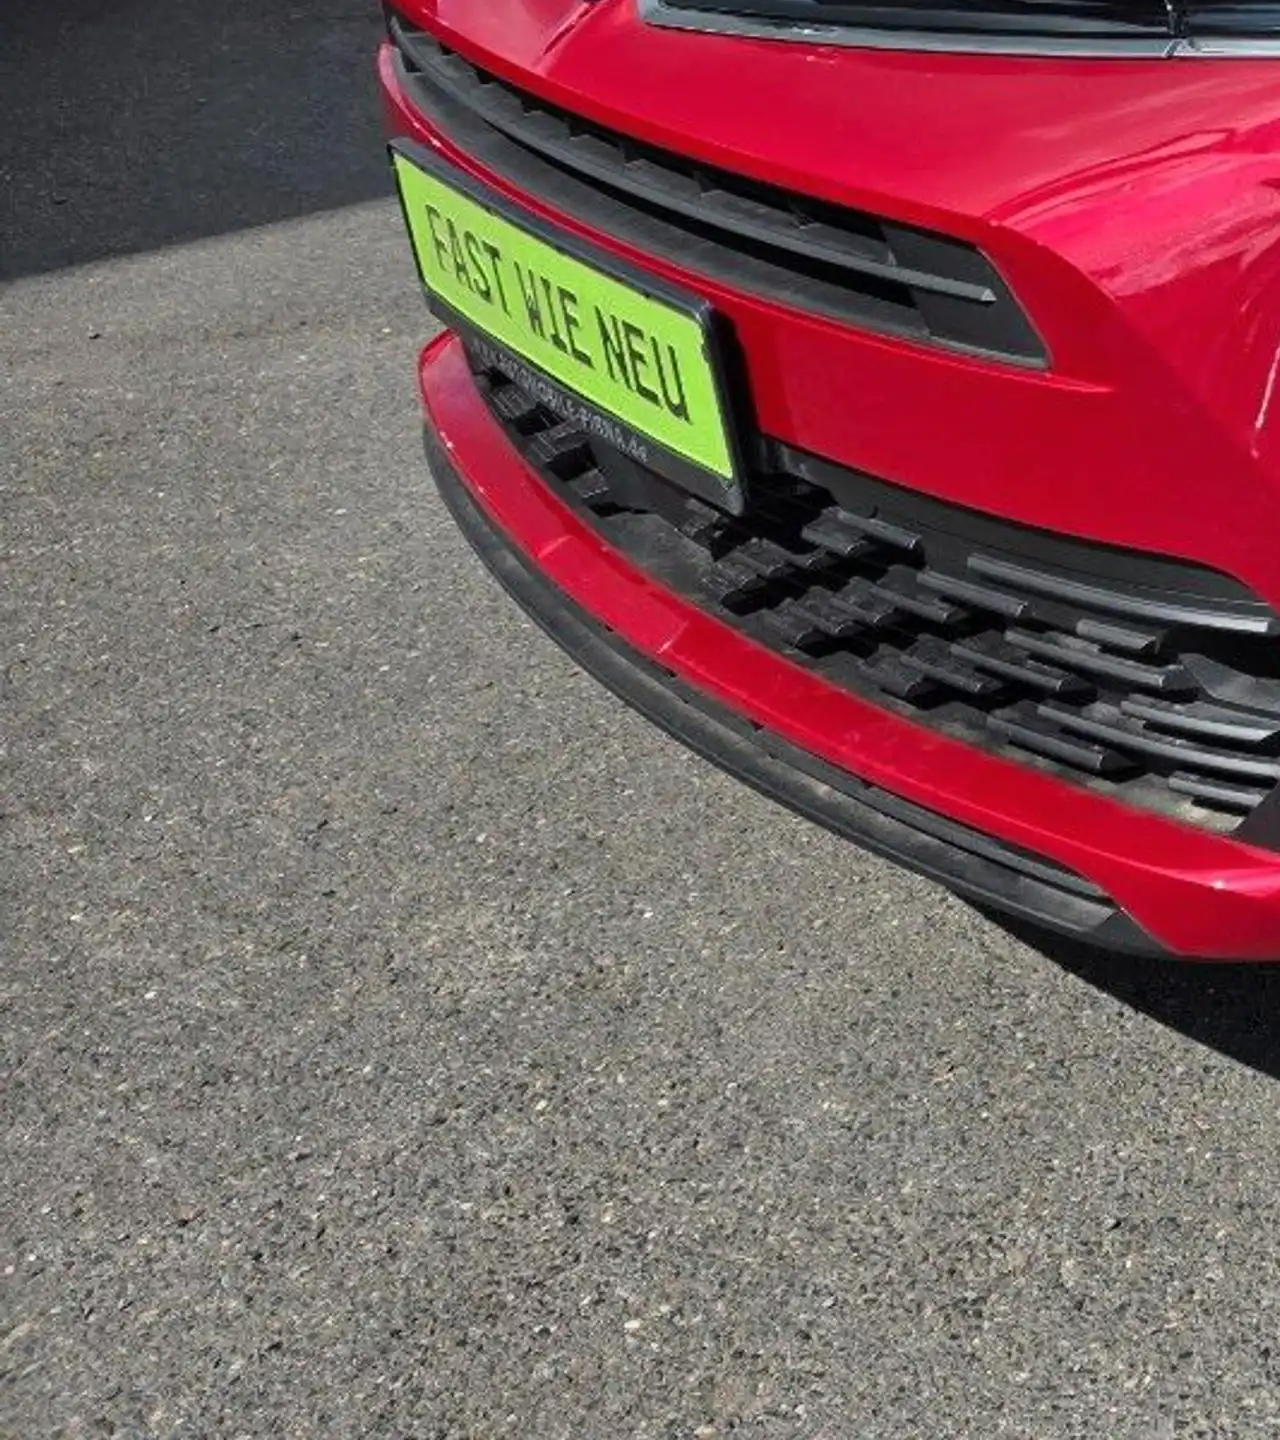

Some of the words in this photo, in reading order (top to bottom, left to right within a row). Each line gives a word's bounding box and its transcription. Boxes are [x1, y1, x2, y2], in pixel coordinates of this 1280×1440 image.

[425, 204, 511, 318] FAST
[514, 261, 596, 370] WIE
[594, 304, 694, 426] NEU
